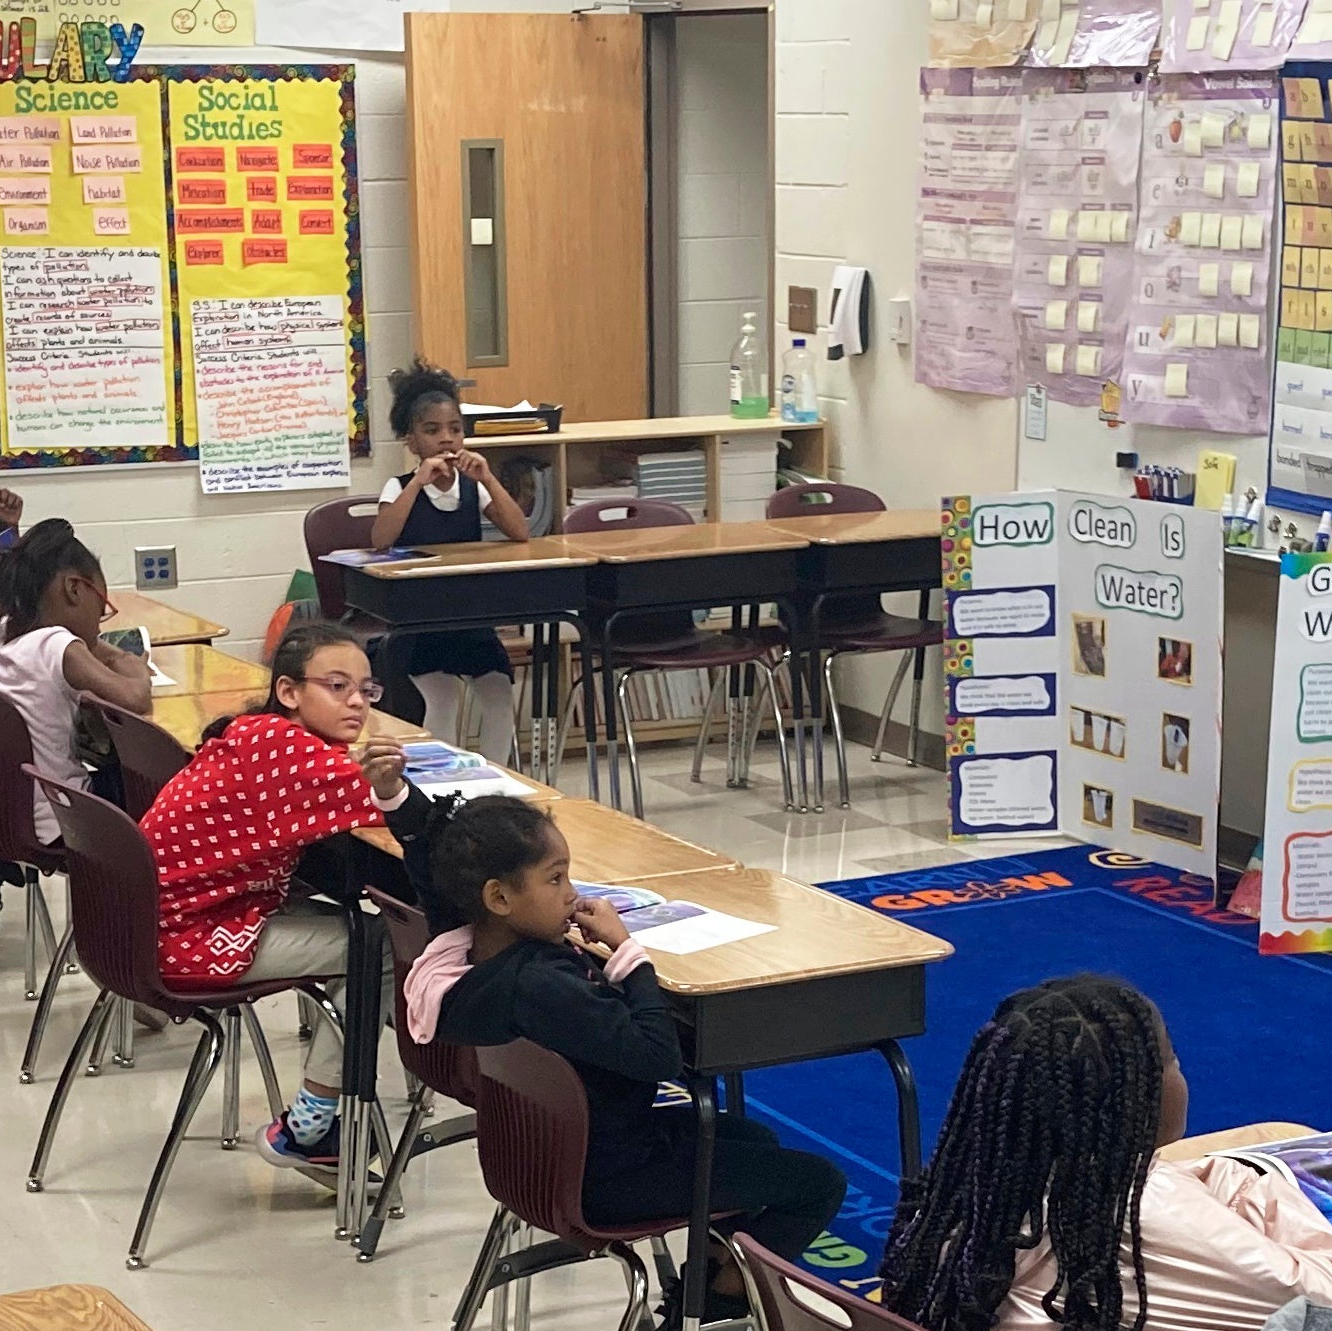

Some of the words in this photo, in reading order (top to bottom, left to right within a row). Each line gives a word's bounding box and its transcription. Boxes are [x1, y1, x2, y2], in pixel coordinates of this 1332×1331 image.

[15, 85, 119, 113] Science
[198, 85, 279, 112] Social
[23, 126, 60, 140] Pollution
[77, 125, 96, 138] Land
[100, 126, 132, 138] Pollution
[184, 113, 283, 141] Studies
[0, 154, 14, 168] Air
[20, 154, 49, 167] Pollution
[76, 154, 102, 169] Noise
[106, 155, 140, 170] Pollution
[87, 185, 121, 199] habitat
[8, 217, 46, 232] Organism
[98, 216, 127, 230] effect
[979, 514, 1050, 541] How
[1074, 508, 1132, 542] Clean
[1163, 523, 1181, 551] Is
[1100, 573, 1180, 611] Water?
